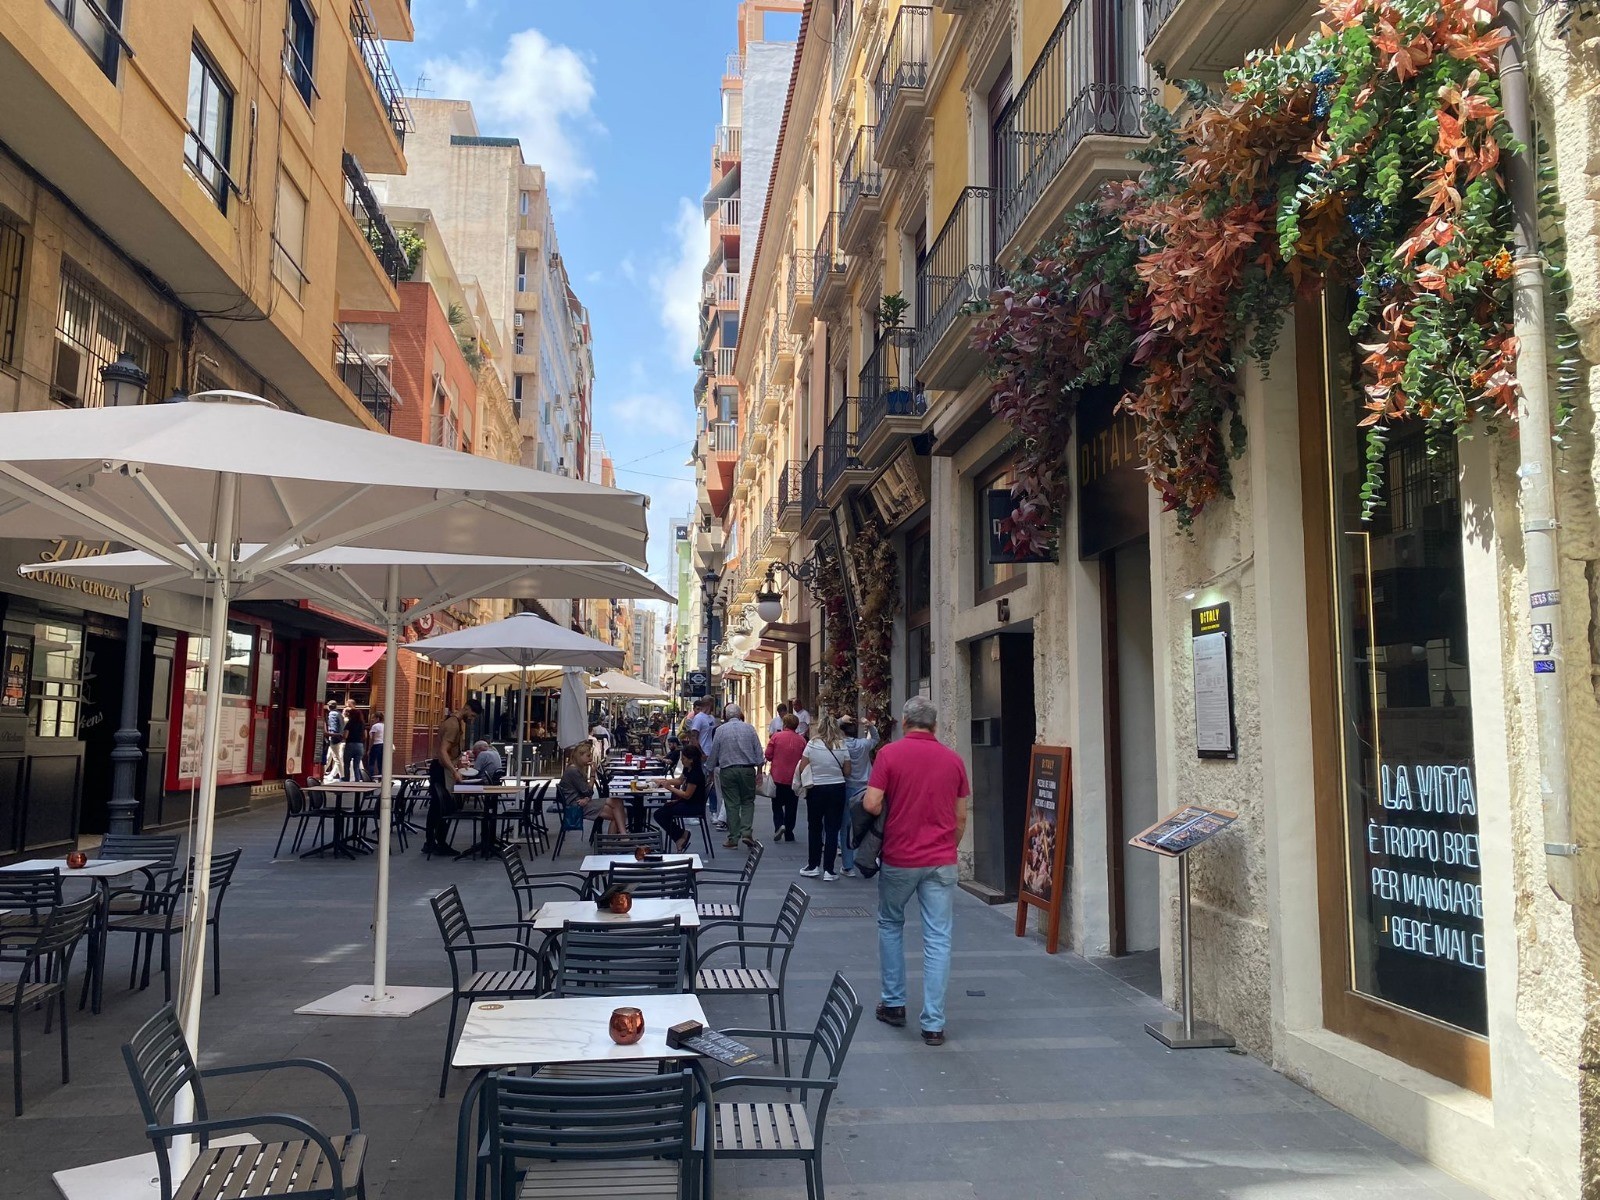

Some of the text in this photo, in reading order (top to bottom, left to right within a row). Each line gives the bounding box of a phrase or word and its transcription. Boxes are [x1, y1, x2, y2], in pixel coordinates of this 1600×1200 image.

[82, 579, 120, 601] CERVEZA
[80, 711, 104, 729] kens
[1382, 764, 1477, 816] LA VITA
[1368, 817, 1381, 854] È
[1381, 825, 1440, 862] TROPPO
[1371, 866, 1484, 919] PER MANGIARE
[1391, 915, 1486, 969] BERE MALE
